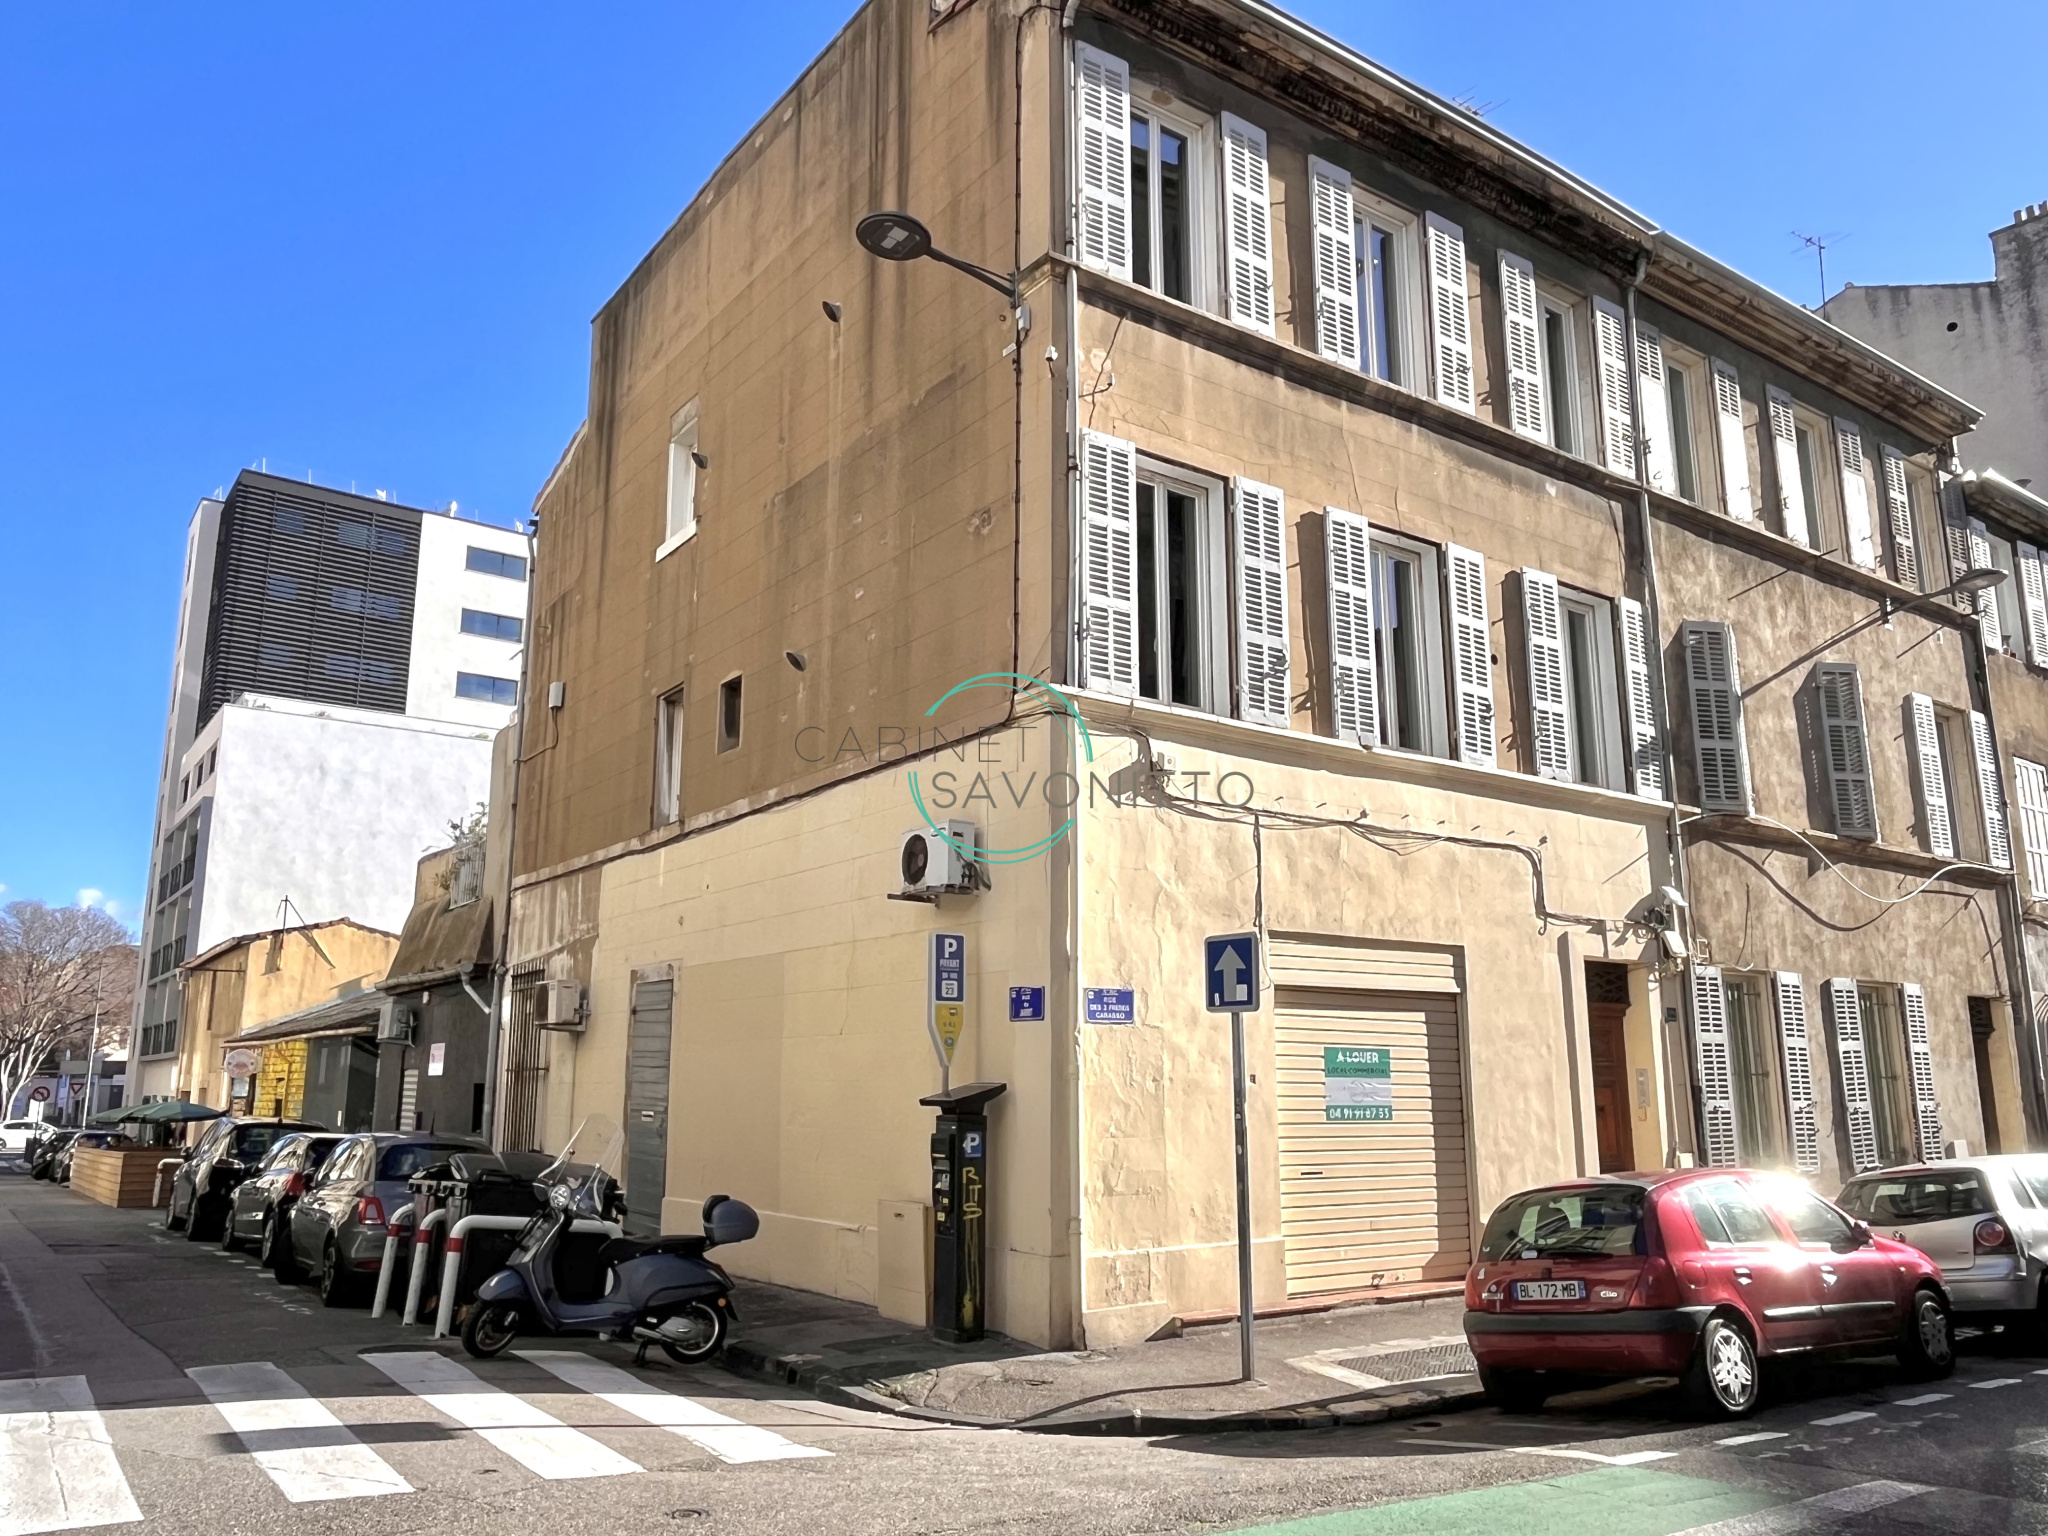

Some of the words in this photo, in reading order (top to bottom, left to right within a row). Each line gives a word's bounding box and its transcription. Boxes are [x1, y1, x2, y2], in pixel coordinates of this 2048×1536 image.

[944, 938, 958, 958] P
[1346, 1051, 1379, 1063] LOUER
[963, 1133, 980, 1153] P
